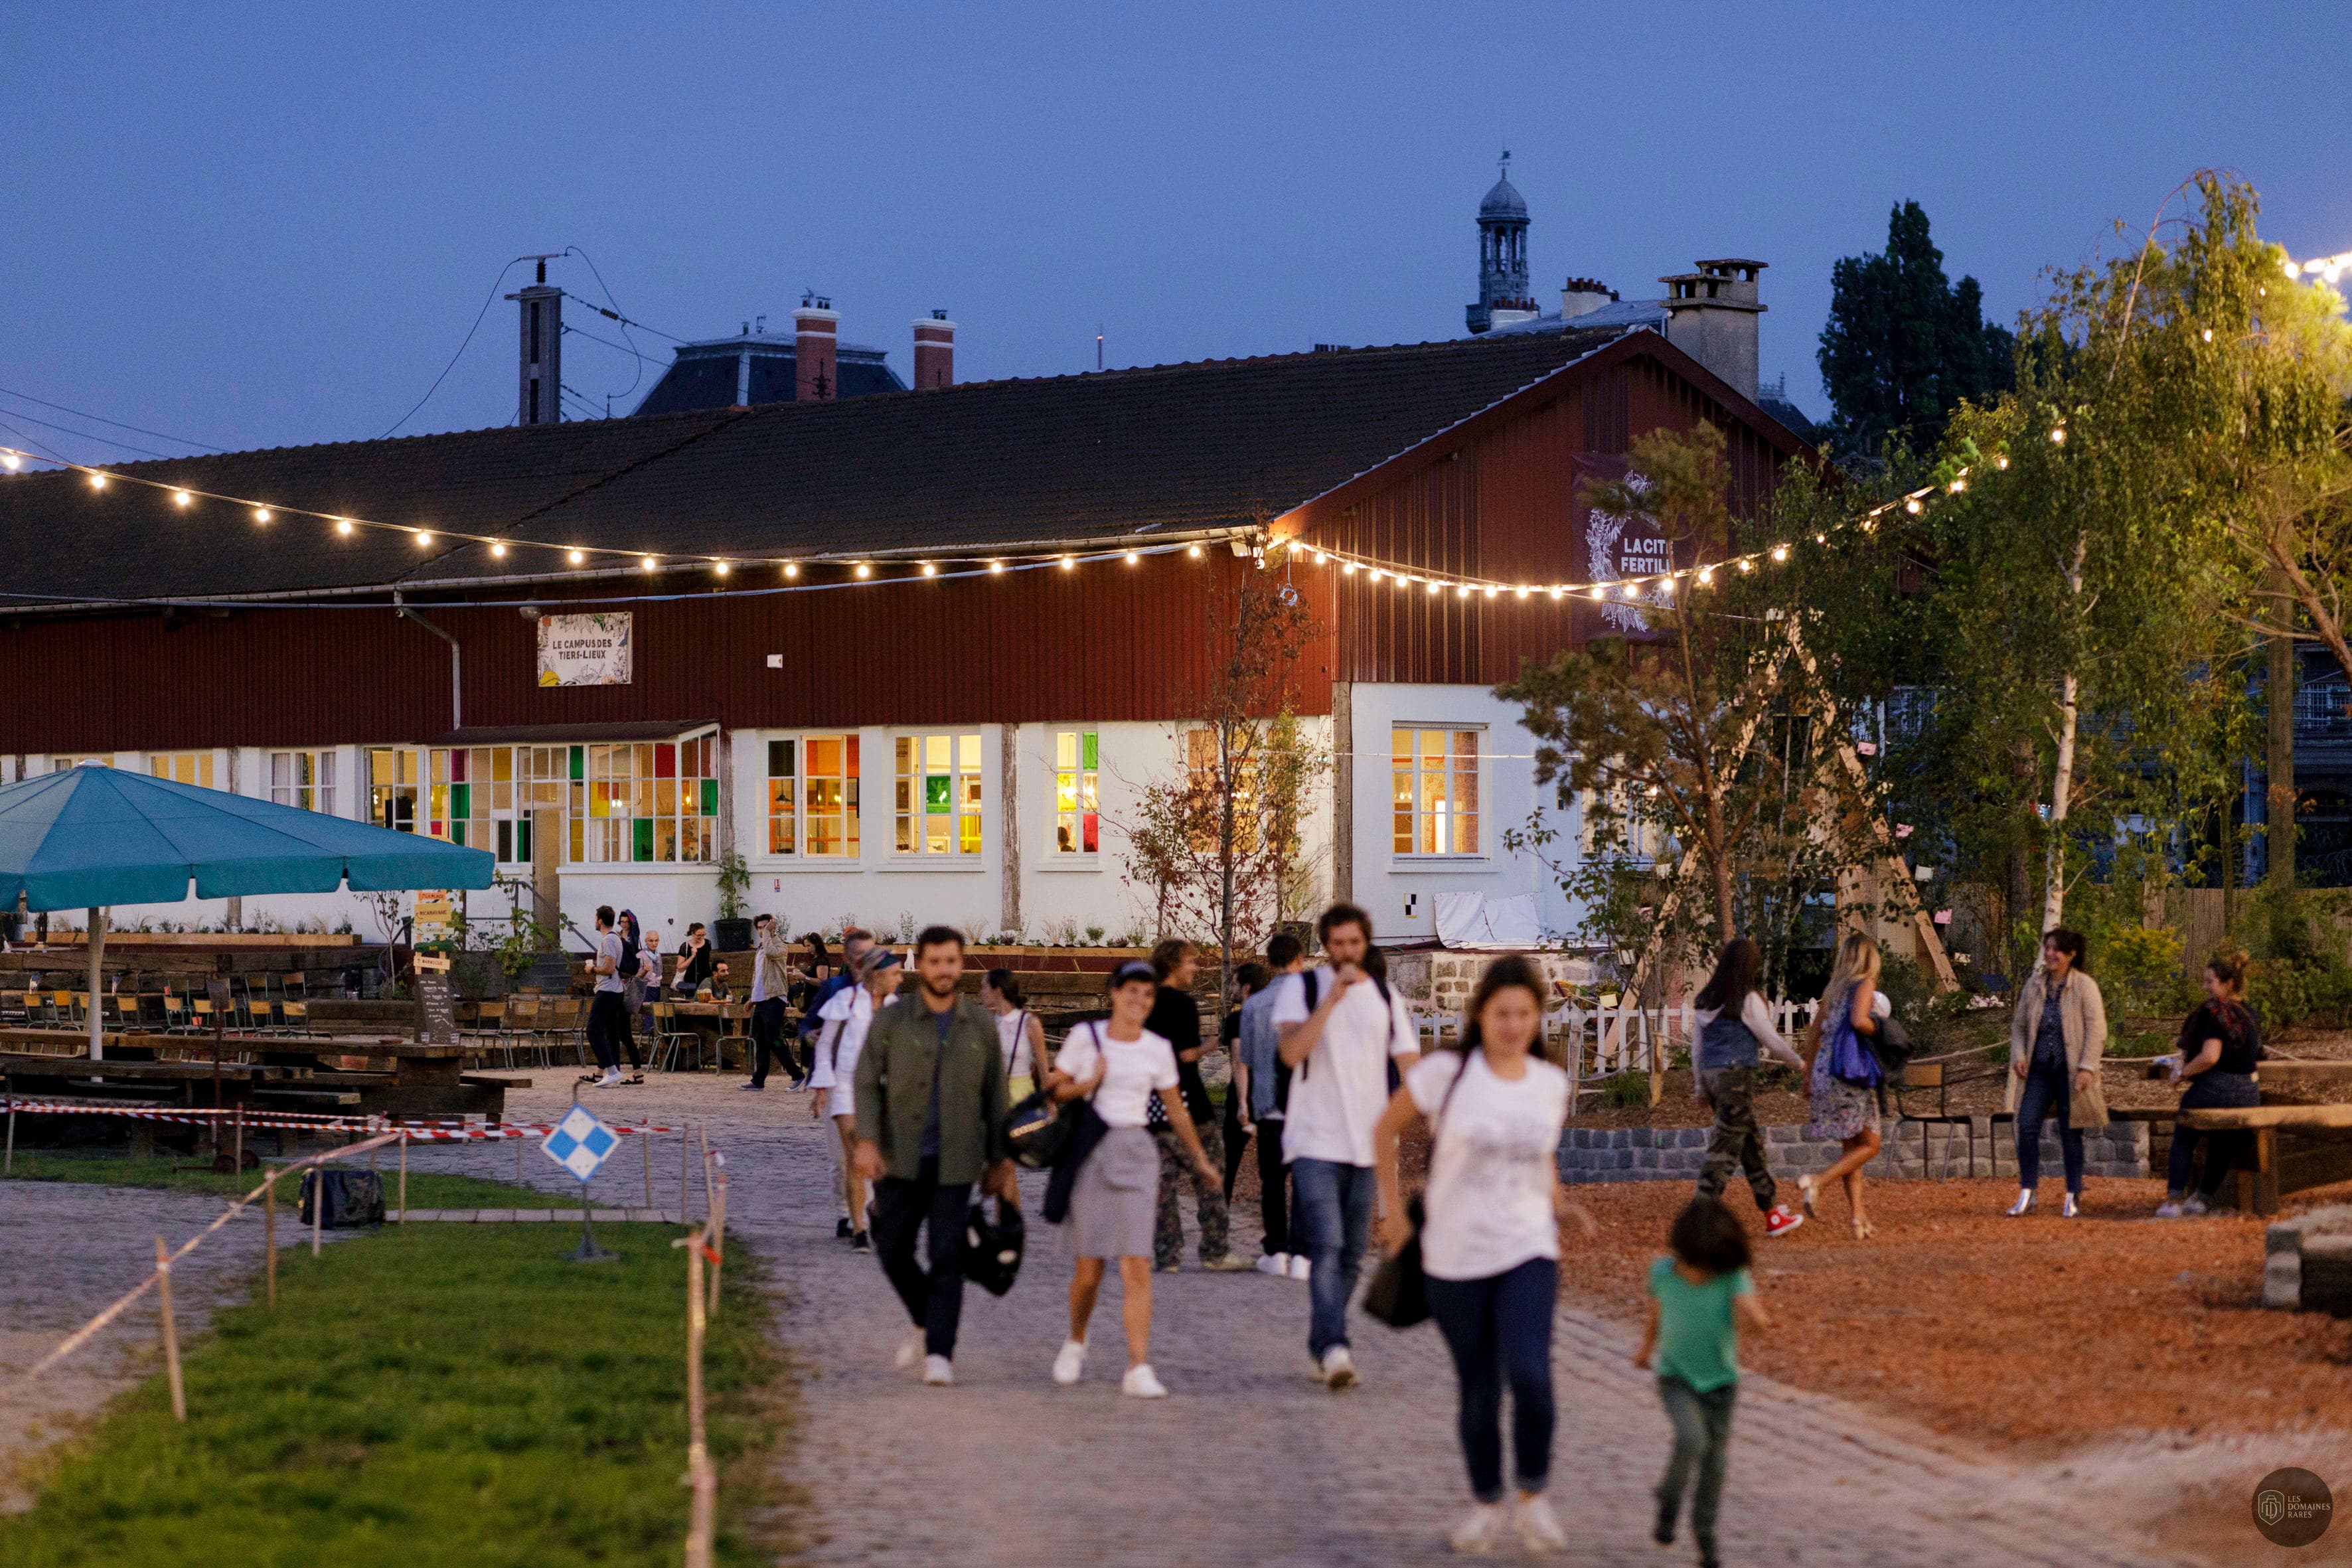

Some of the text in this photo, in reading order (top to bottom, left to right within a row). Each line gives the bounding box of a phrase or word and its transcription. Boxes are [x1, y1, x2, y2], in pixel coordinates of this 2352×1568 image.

[1624, 538, 1673, 554] LA CIT
[552, 639, 612, 649] LE CAMPUS DES
[558, 650, 606, 660] TIERS-LIEUX
